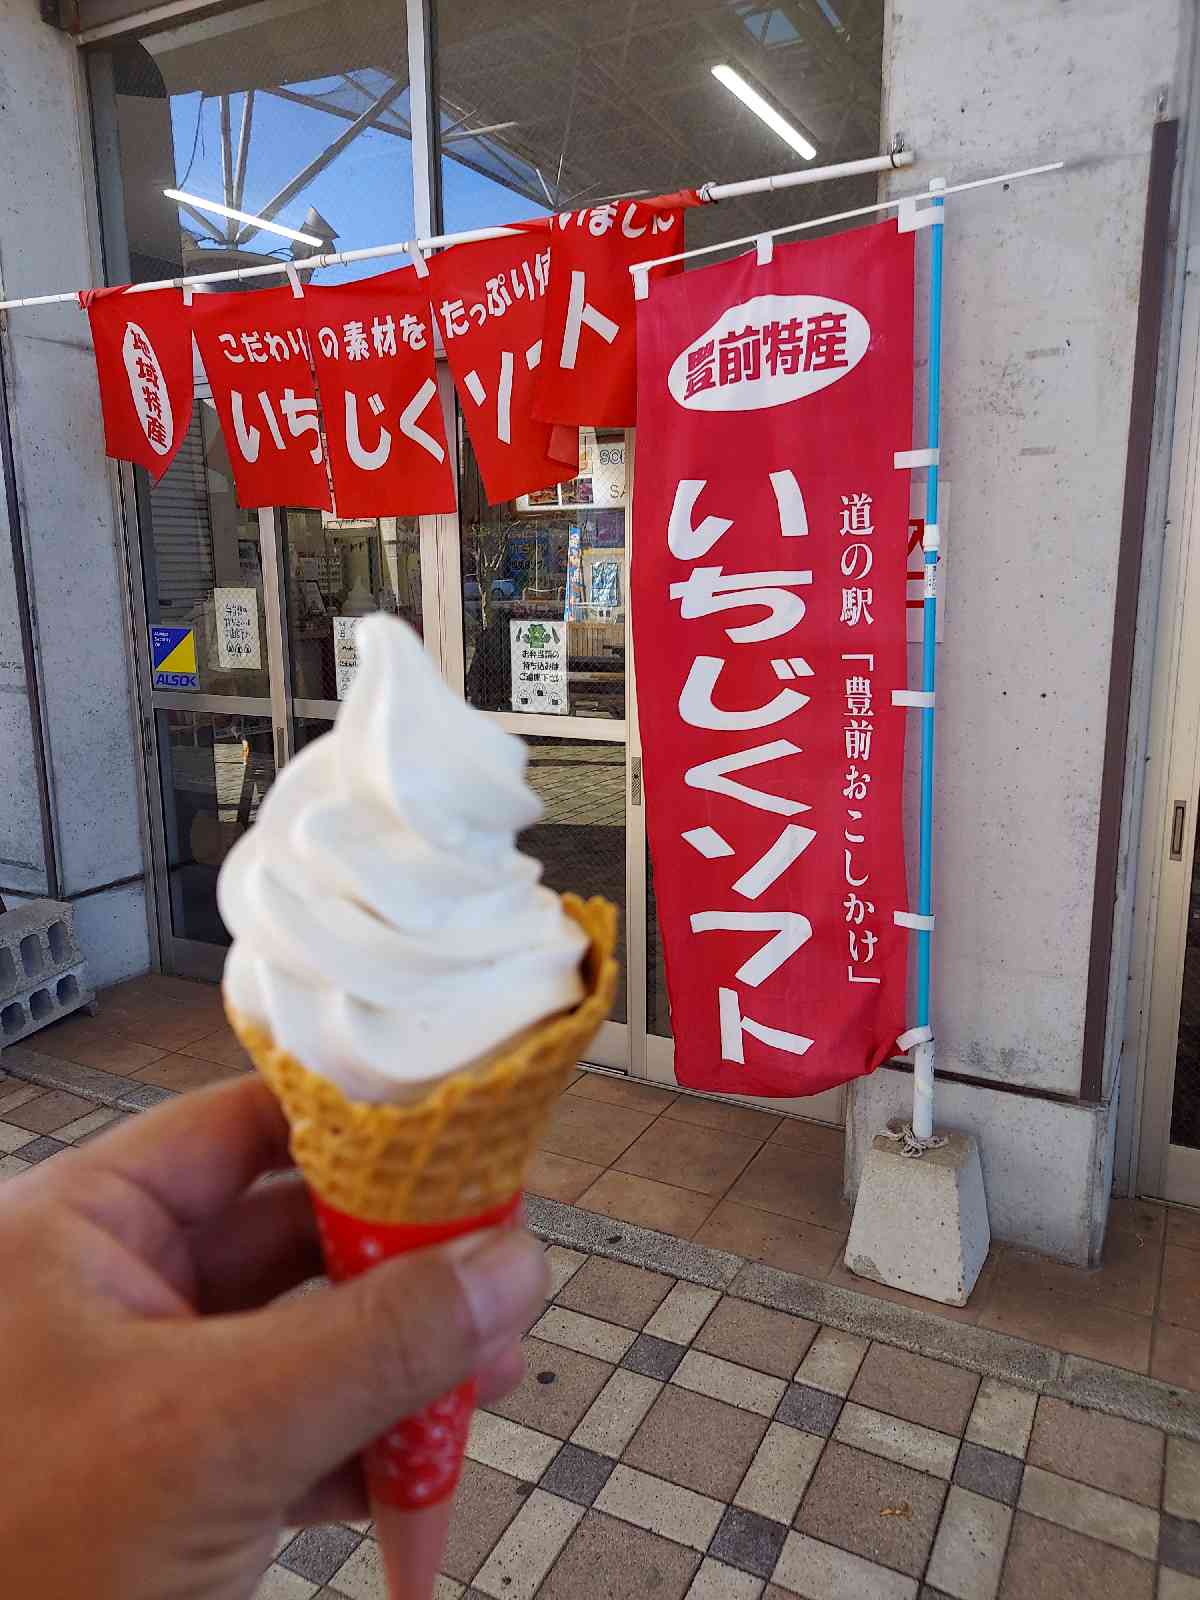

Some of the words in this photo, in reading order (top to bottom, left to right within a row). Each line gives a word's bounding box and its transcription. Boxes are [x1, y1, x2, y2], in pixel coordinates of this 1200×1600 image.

[463, 339, 543, 445] ソ
[683, 312, 849, 401] 豊前特産
[231, 377, 445, 471] いちじく
[156, 674, 197, 687] ALSOK
[667, 469, 817, 1065] いちじくソフト
